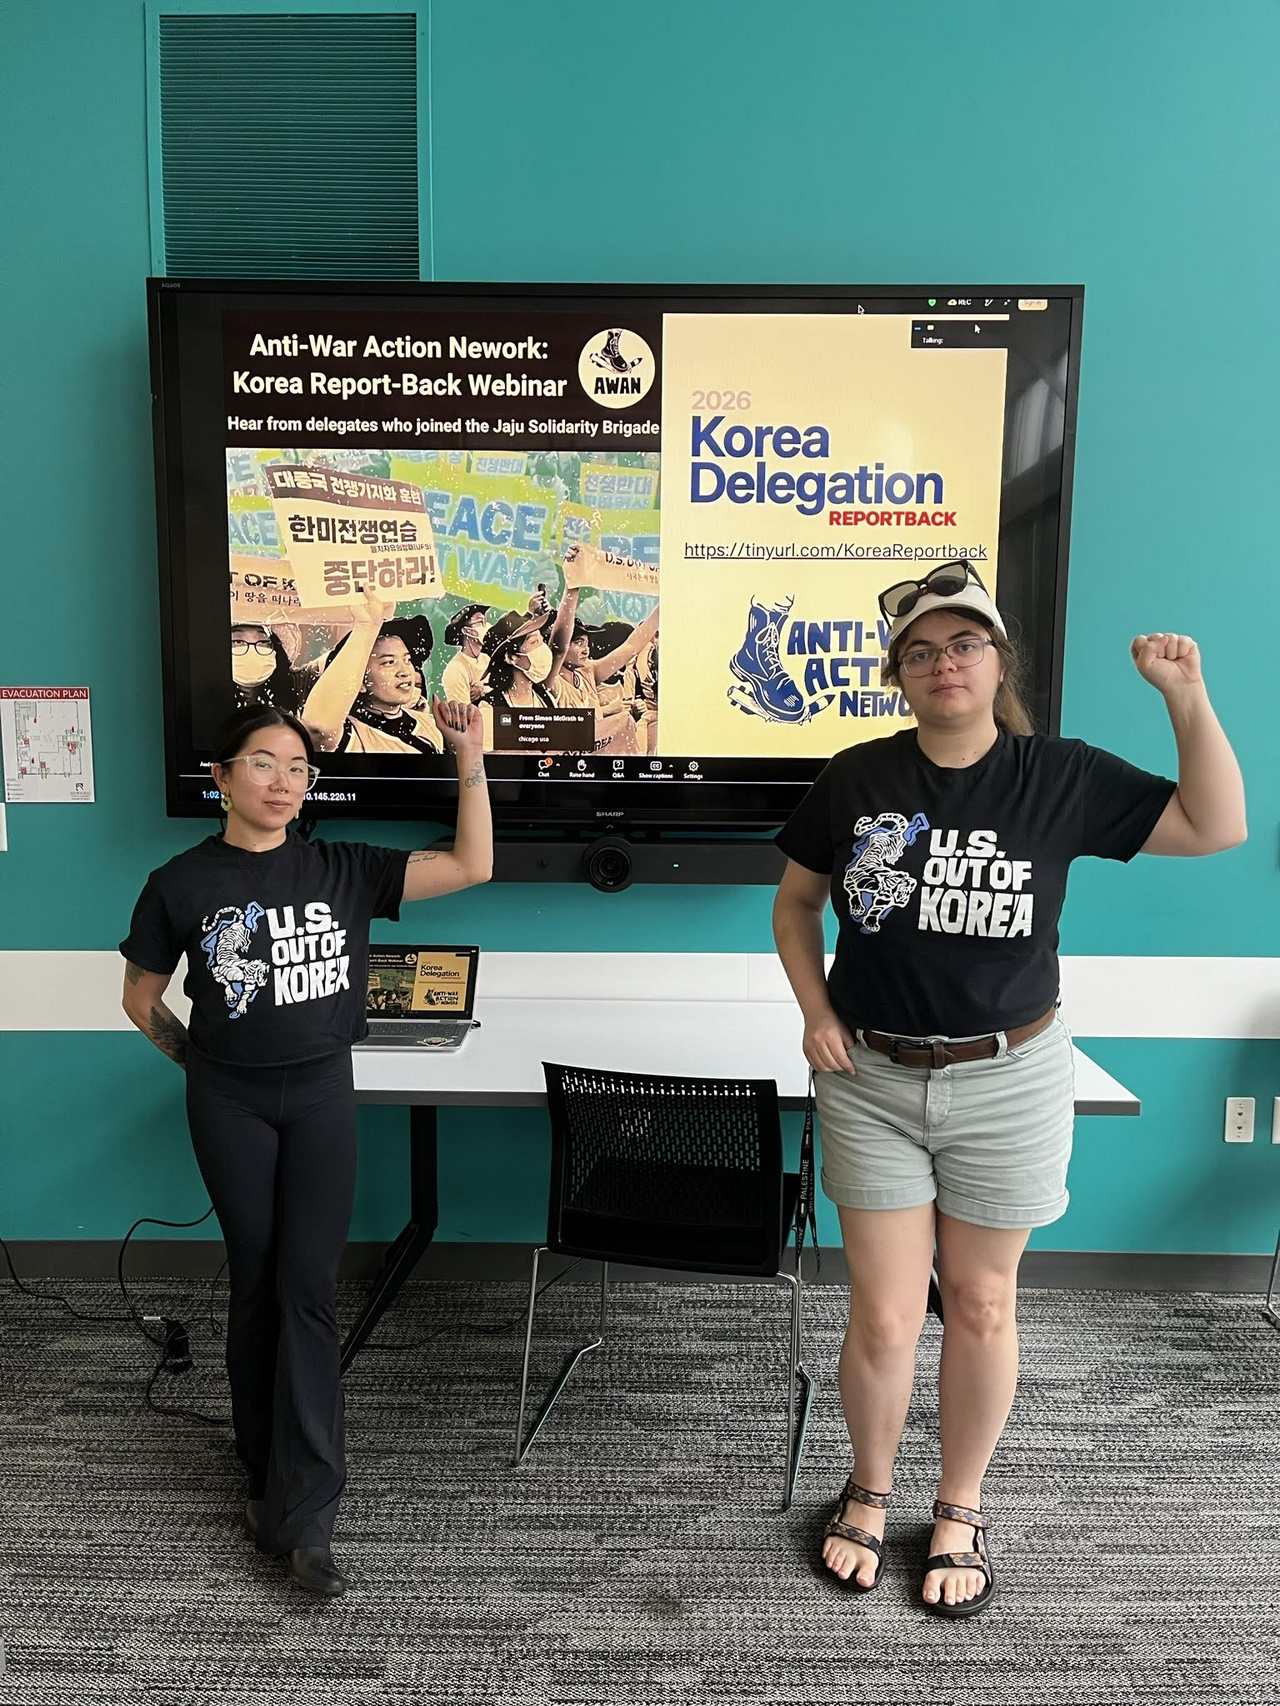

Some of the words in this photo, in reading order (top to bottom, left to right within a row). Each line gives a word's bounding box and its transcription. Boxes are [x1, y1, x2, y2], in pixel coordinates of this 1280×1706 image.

[250, 334, 357, 359] Anti-War
[363, 336, 442, 359] Action
[448, 336, 549, 360] Nework:
[233, 371, 303, 394] Korea
[310, 372, 462, 400] Report-Back
[467, 373, 567, 397] Webinar
[594, 377, 641, 395] AWAN
[691, 390, 751, 411] 2026
[227, 416, 263, 432] Hear
[266, 416, 302, 432] from
[305, 416, 378, 436] delegates
[381, 417, 413, 433] who
[415, 418, 461, 436] joined
[465, 418, 489, 434] the
[493, 418, 525, 438] Jaju
[528, 419, 599, 438] Solidarity
[602, 420, 660, 439] Brigade
[691, 415, 830, 458] Korea
[690, 462, 943, 516] Delegation
[229, 512, 279, 546] ACE
[288, 514, 417, 545] 한미전쟁연습
[423, 489, 547, 551] EACE
[829, 510, 957, 527] REPORTBACK
[684, 542, 988, 561] https://tinyurl.com/KoreaReportback
[324, 556, 436, 596] 중단하라!
[2, 689, 61, 698] EVACUATION
[63, 689, 87, 698] PLAN
[519, 714, 534, 722] From
[202, 791, 220, 800] 1:02
[929, 829, 1007, 858] U.S.
[923, 857, 988, 888] OUT
[989, 860, 1033, 891] OF
[266, 901, 339, 940] U.S.
[918, 886, 1034, 938] KOREA
[271, 935, 319, 966] OUT
[320, 929, 347, 959] OF
[273, 955, 350, 1006] KOREA
[420, 970, 460, 978] Delegation
[800, 1159, 810, 1200] PALESTINE
